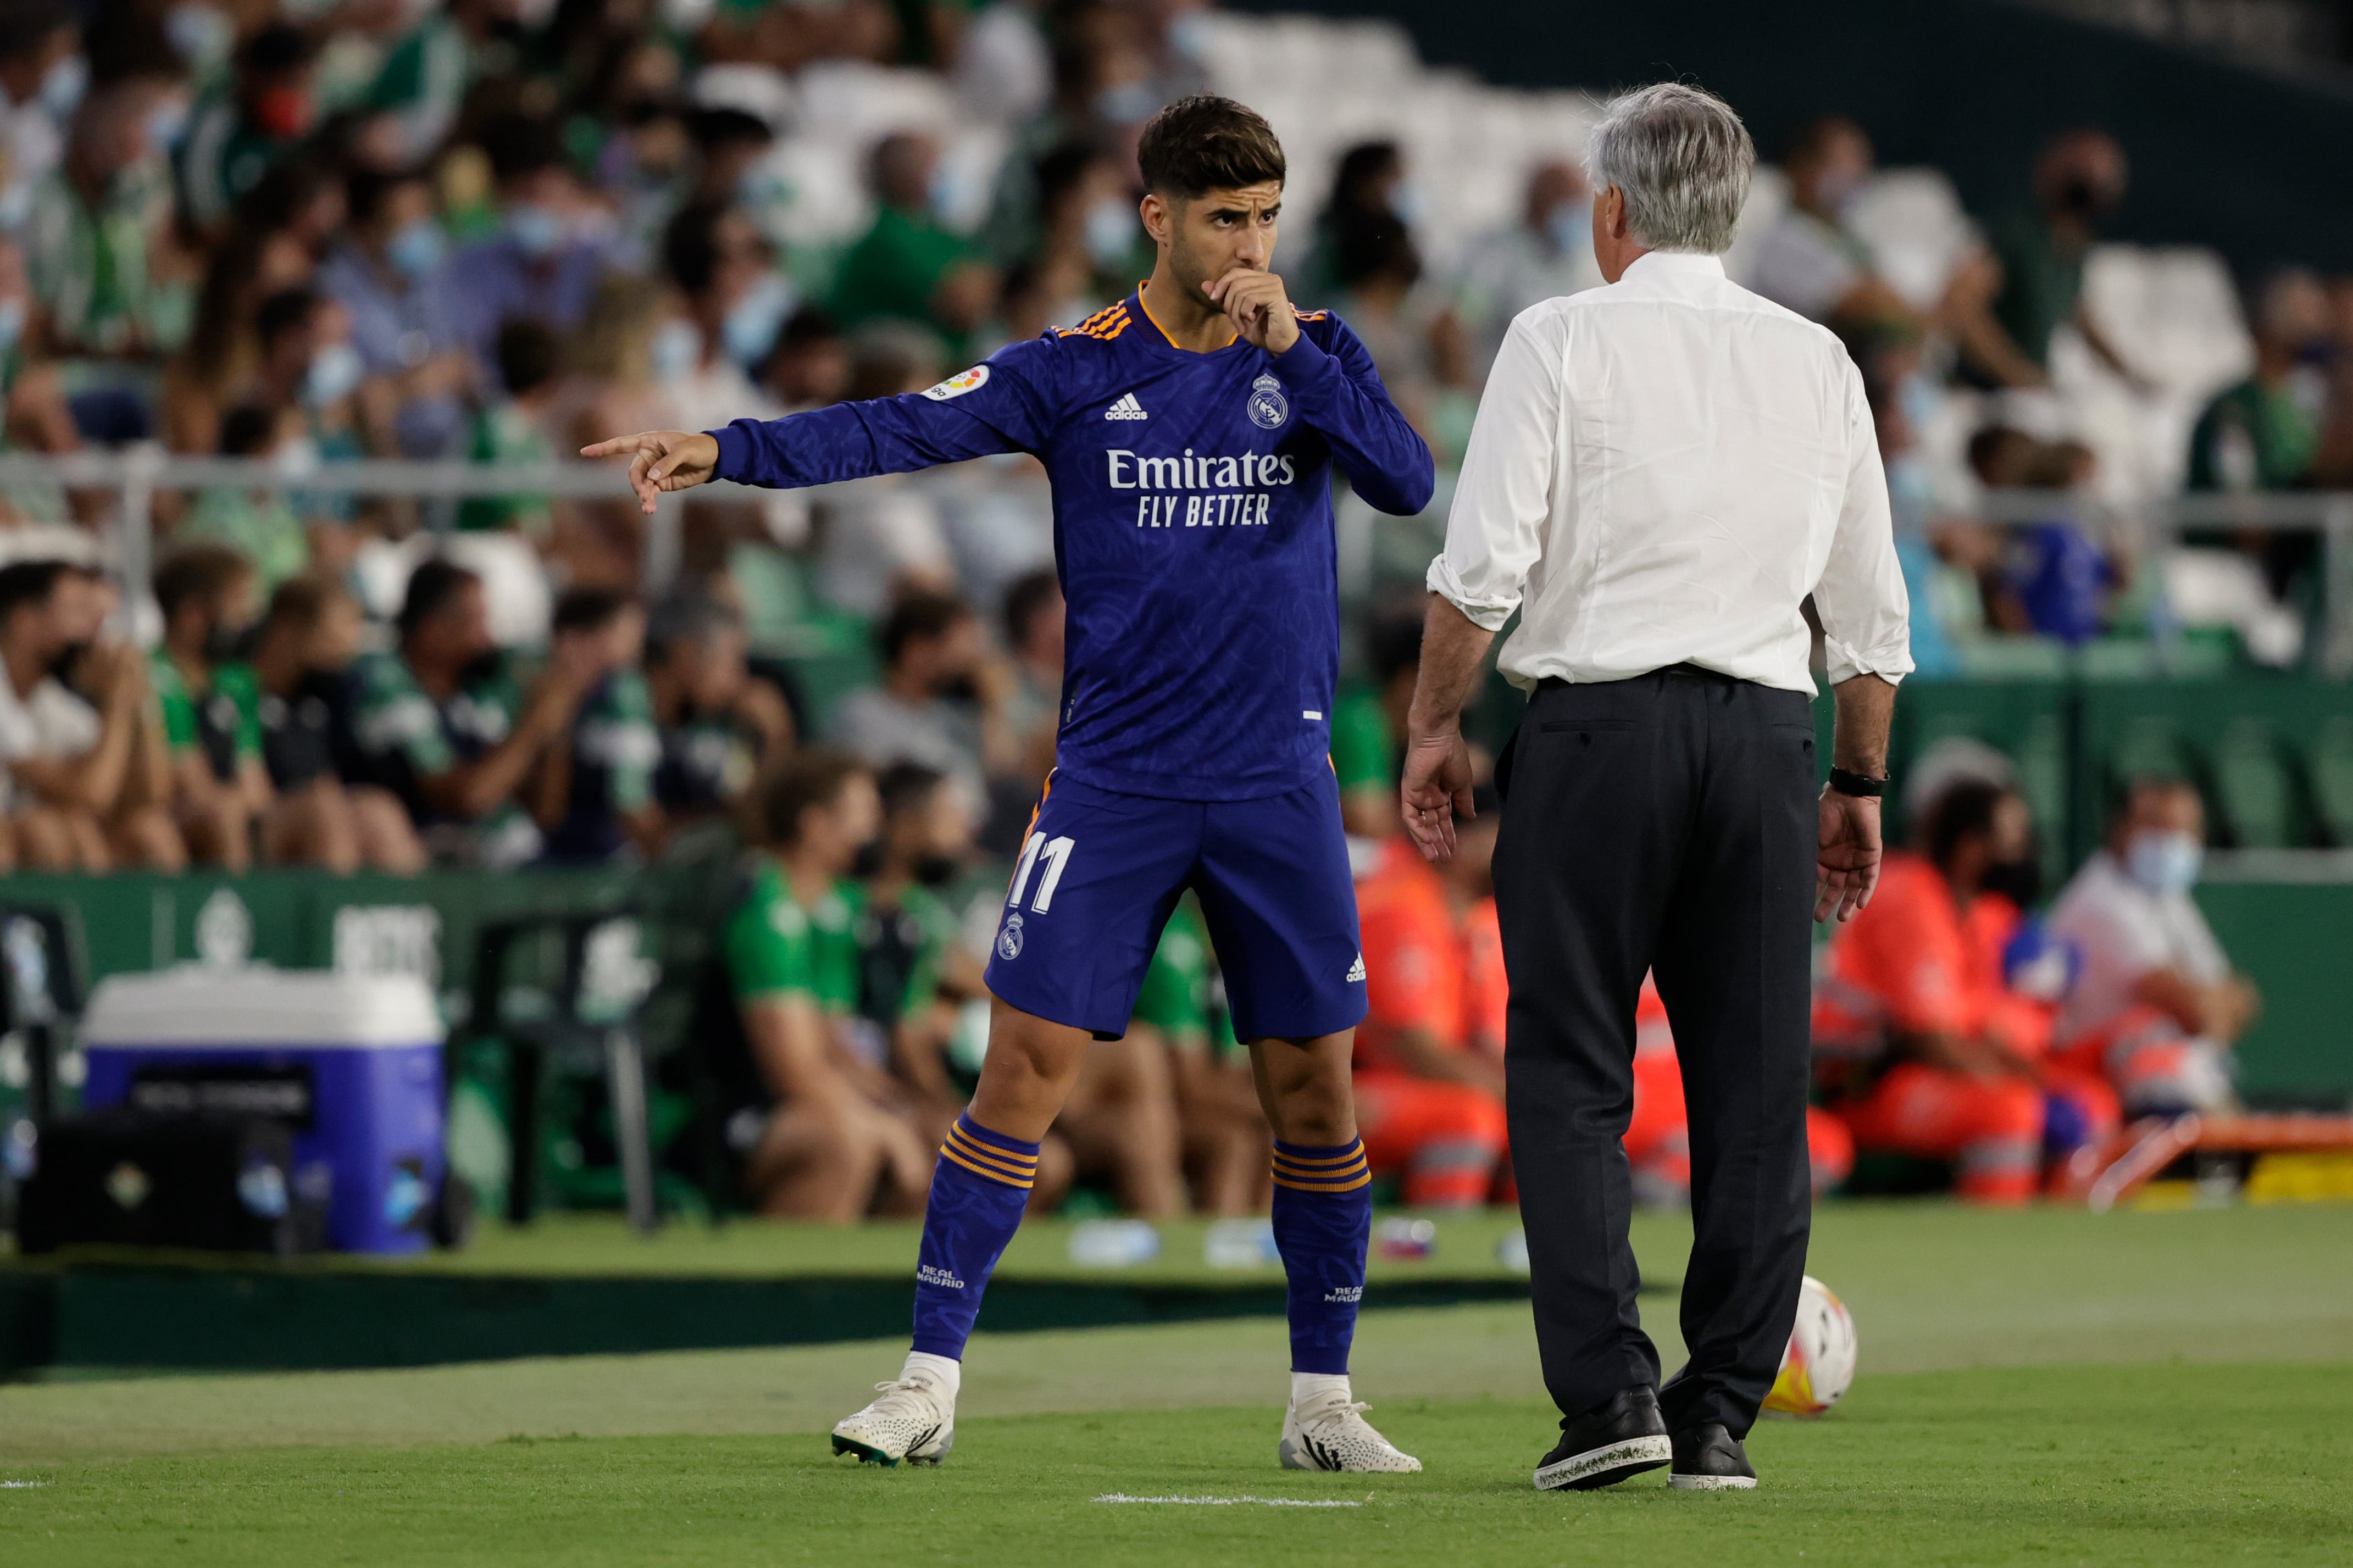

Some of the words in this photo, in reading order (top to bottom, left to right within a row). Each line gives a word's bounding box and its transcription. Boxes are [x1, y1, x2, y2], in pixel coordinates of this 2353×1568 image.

[1105, 409, 1148, 420] adidas
[1106, 448, 1295, 489] Emirates
[1137, 496, 1178, 527] FLY
[1185, 493, 1269, 526] BETTER
[1009, 831, 1075, 915] 11
[917, 1271, 964, 1289] MADRID
[923, 1265, 956, 1280] REAL
